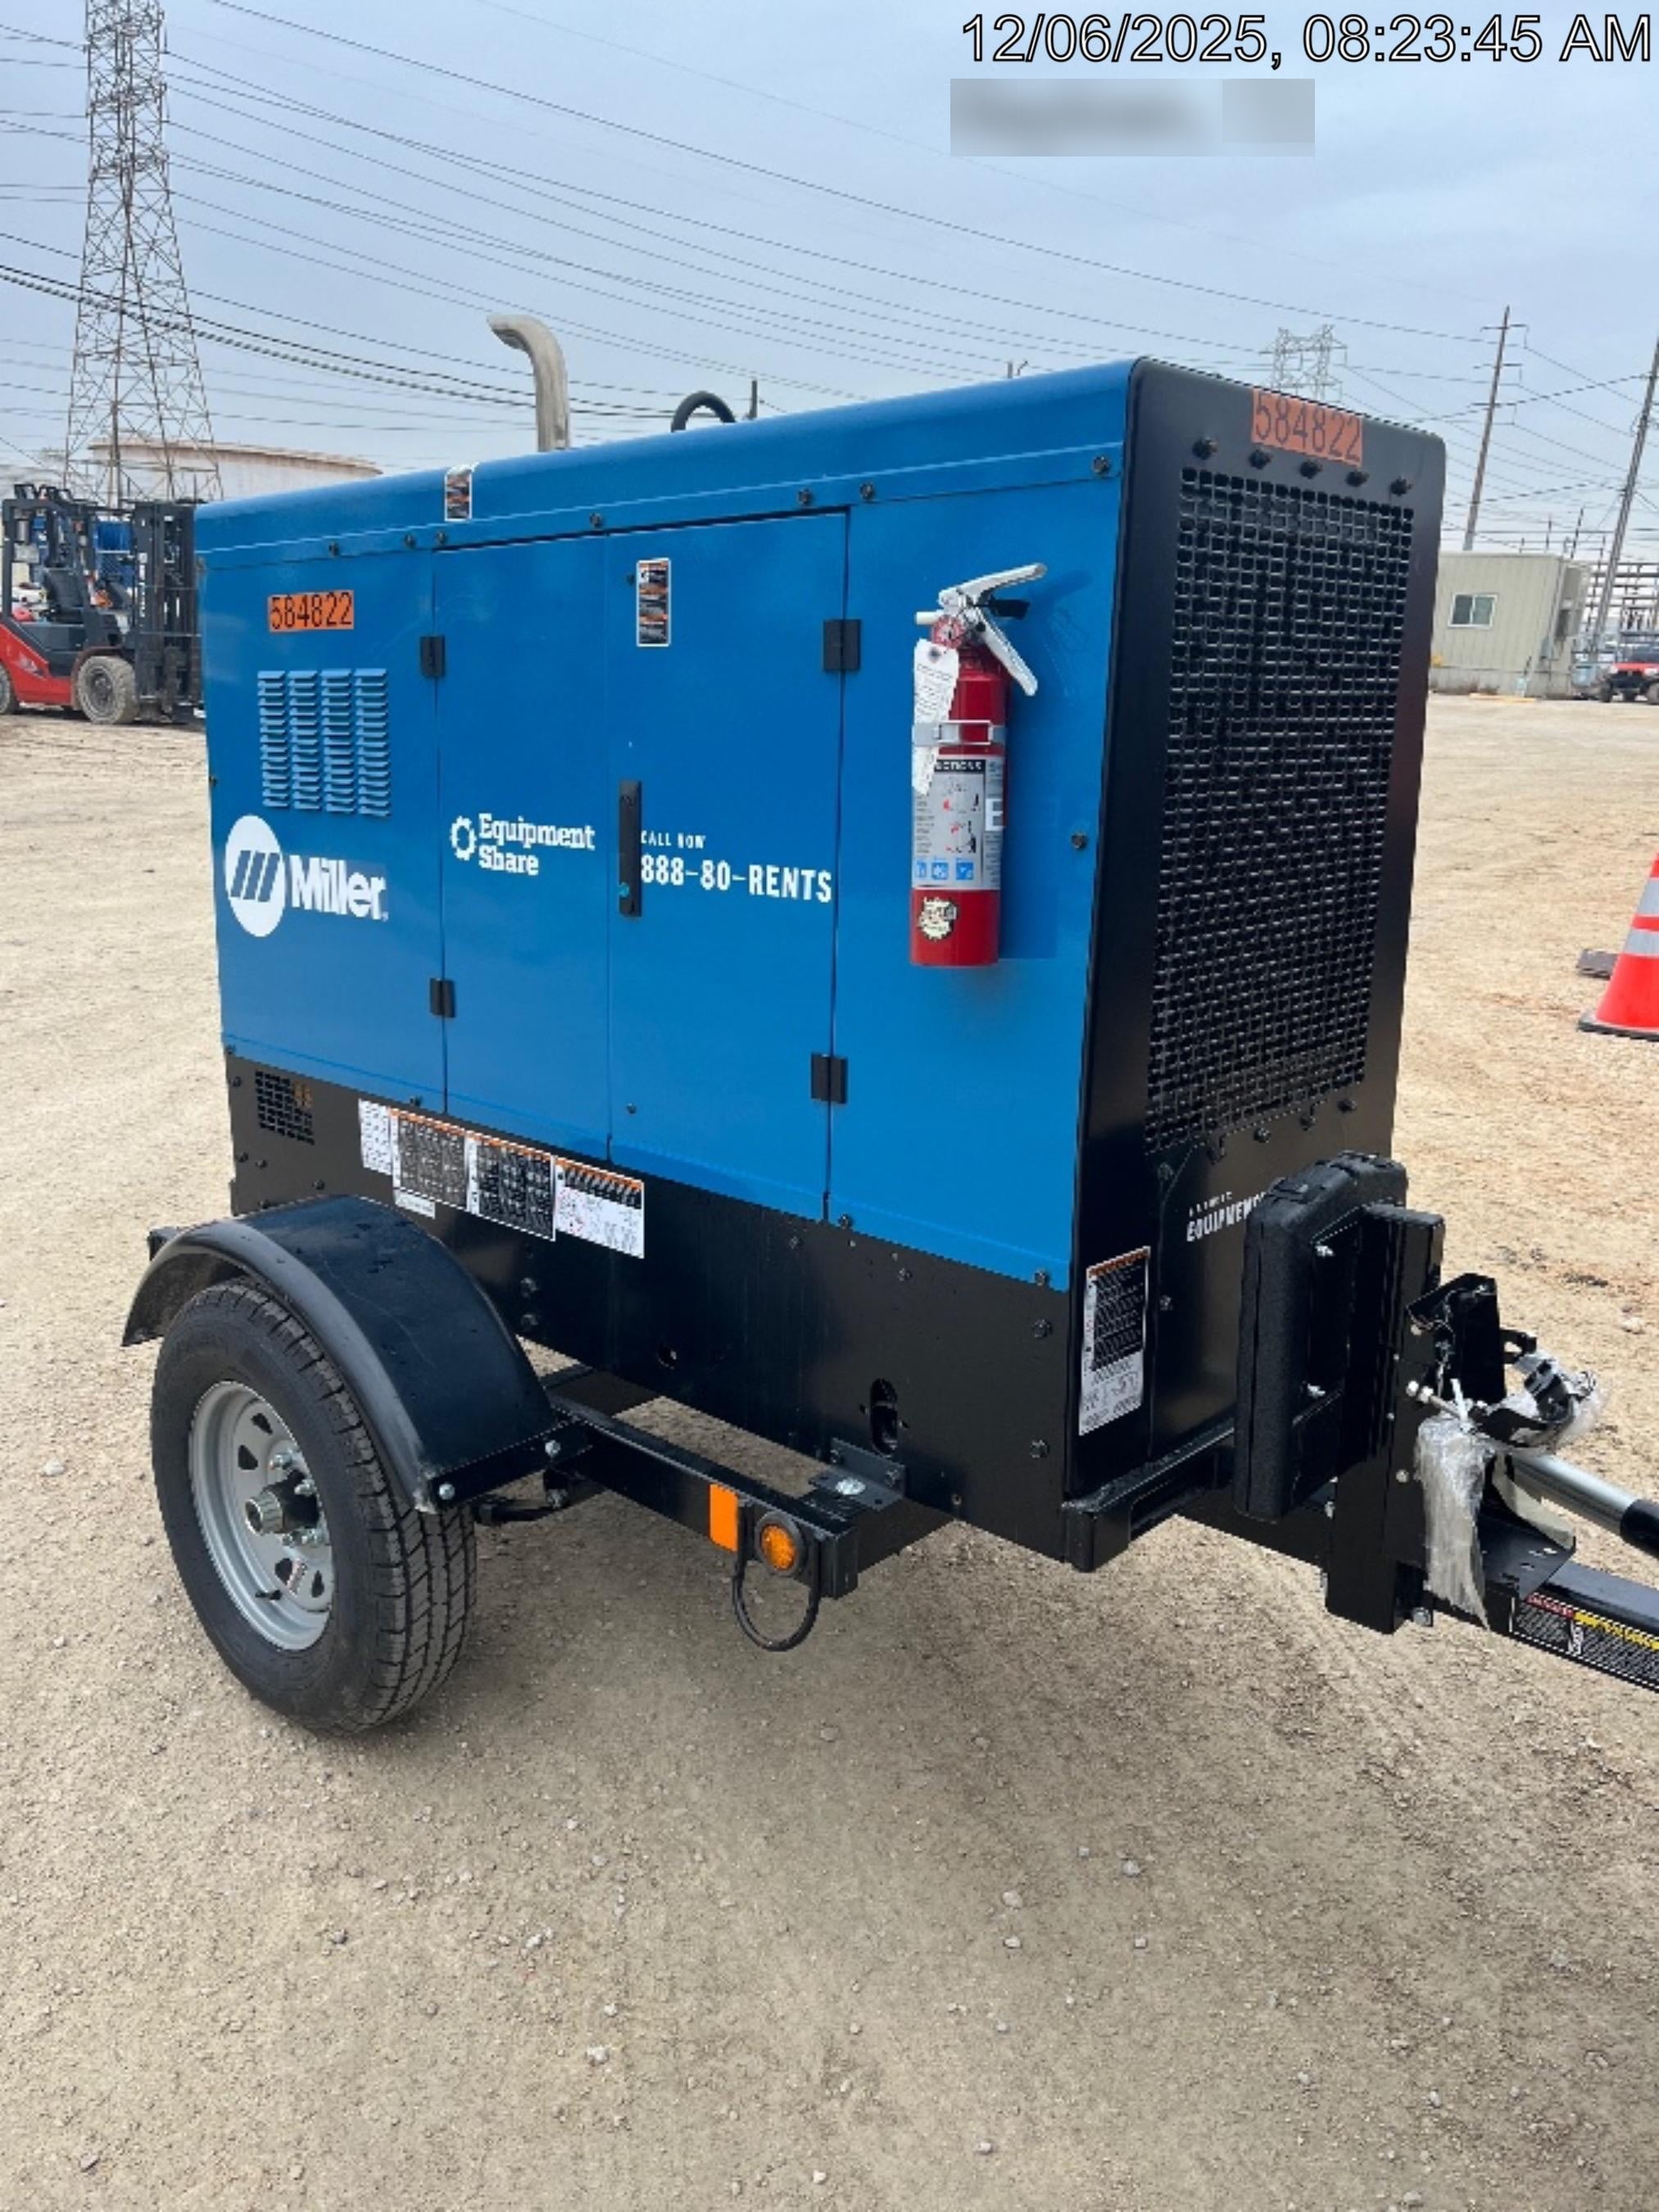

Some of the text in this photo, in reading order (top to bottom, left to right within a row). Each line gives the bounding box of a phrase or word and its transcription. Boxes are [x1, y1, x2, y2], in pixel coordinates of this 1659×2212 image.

[1254, 390, 1362, 463] 584822
[271, 592, 353, 630] 584822
[478, 812, 596, 851] Equipment
[641, 829, 706, 850] CALL NOW
[478, 845, 540, 877] Share
[641, 853, 832, 903] 888-80-RENTS
[289, 854, 387, 920] Miller
